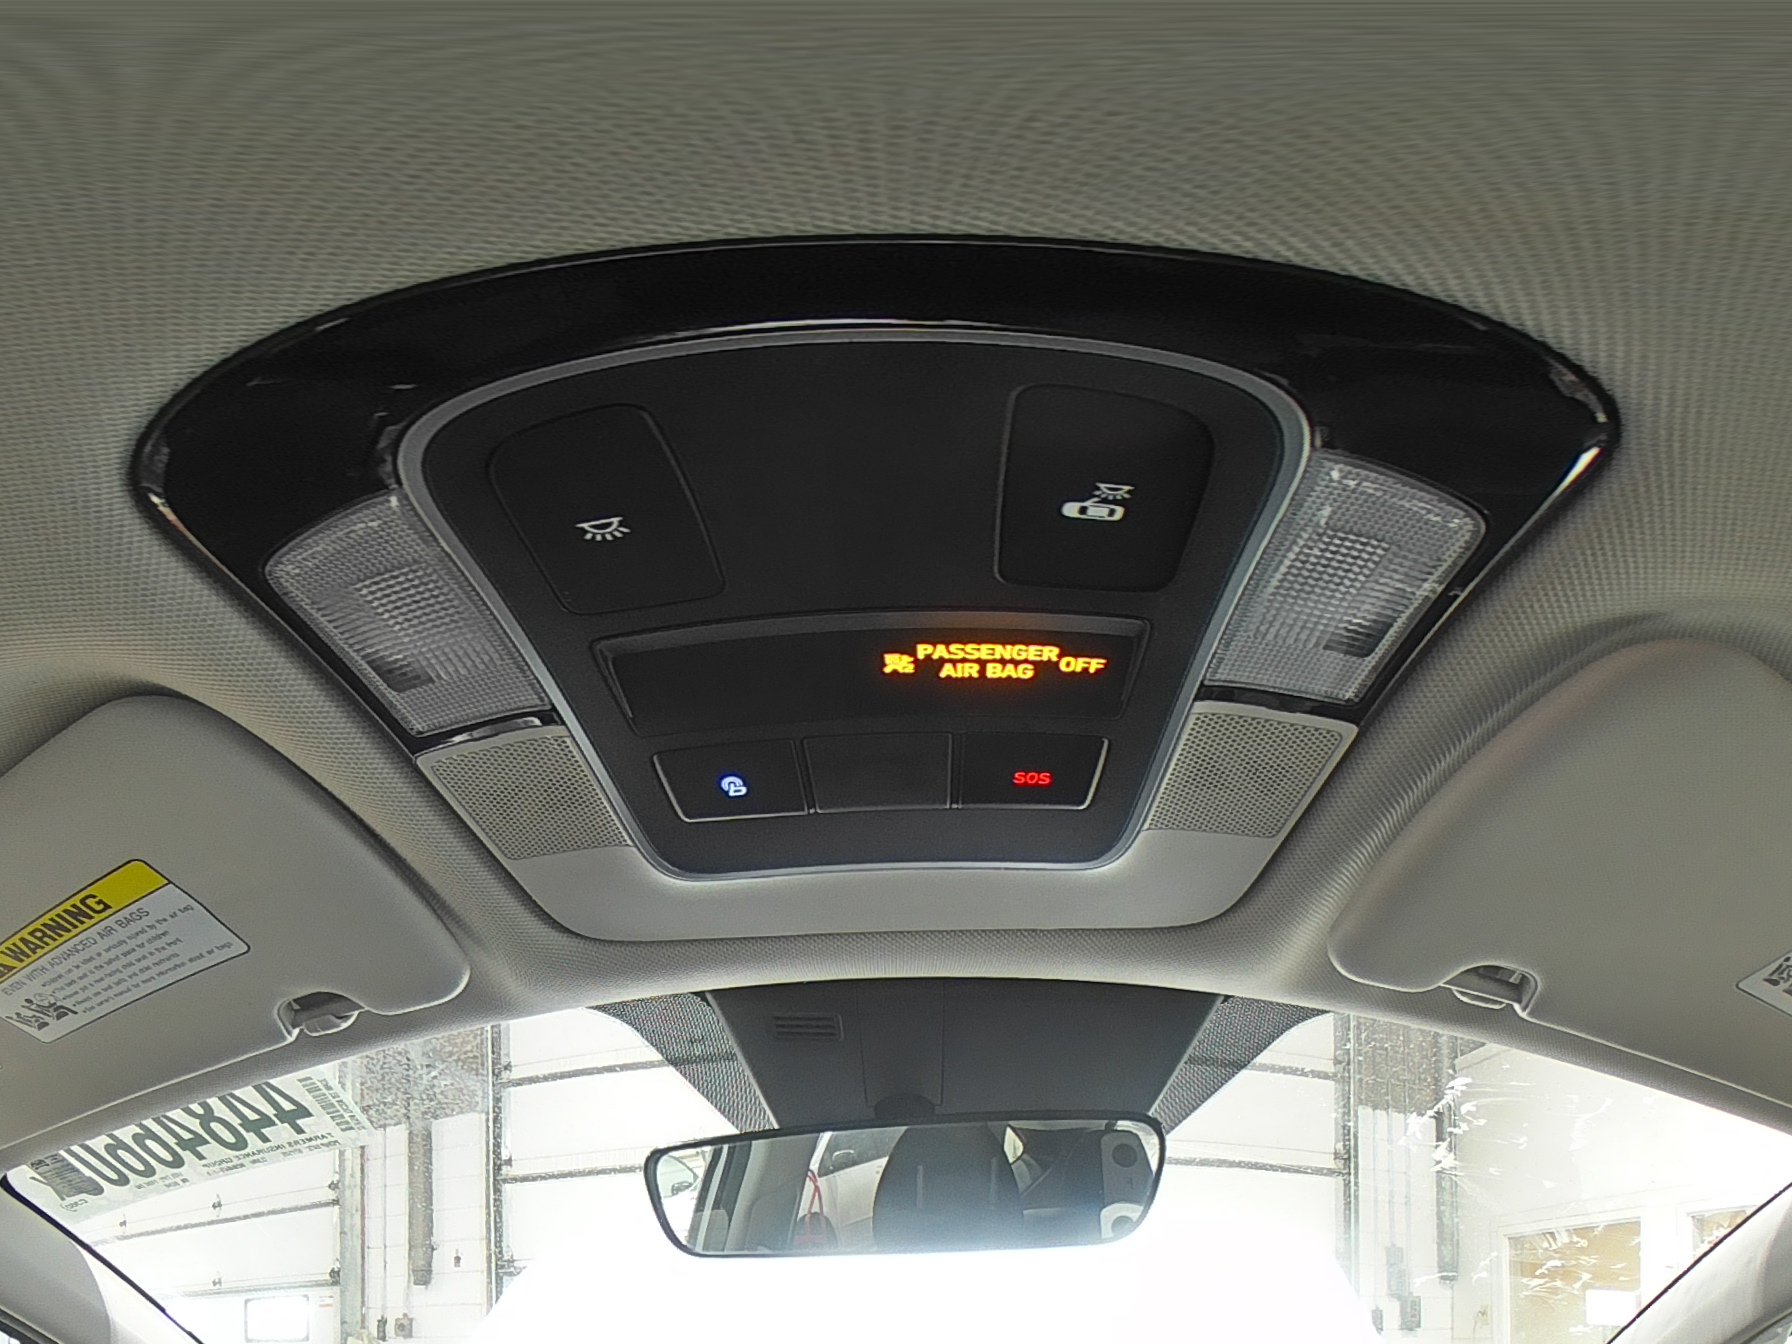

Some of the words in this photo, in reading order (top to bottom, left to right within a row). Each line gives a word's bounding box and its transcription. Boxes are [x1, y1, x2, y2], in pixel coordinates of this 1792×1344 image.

[916, 643, 1059, 662] PASSENGER
[939, 663, 979, 678] AIR
[985, 663, 1035, 679] BAG
[1058, 656, 1107, 674] OFF
[1012, 771, 1052, 786] SOS
[0, 894, 112, 963] WARNING
[1, 978, 27, 996] EVEN
[24, 965, 49, 982] WITH
[49, 936, 97, 969] ADVANCED
[96, 925, 118, 940] AIR
[115, 907, 150, 928] BAGS
